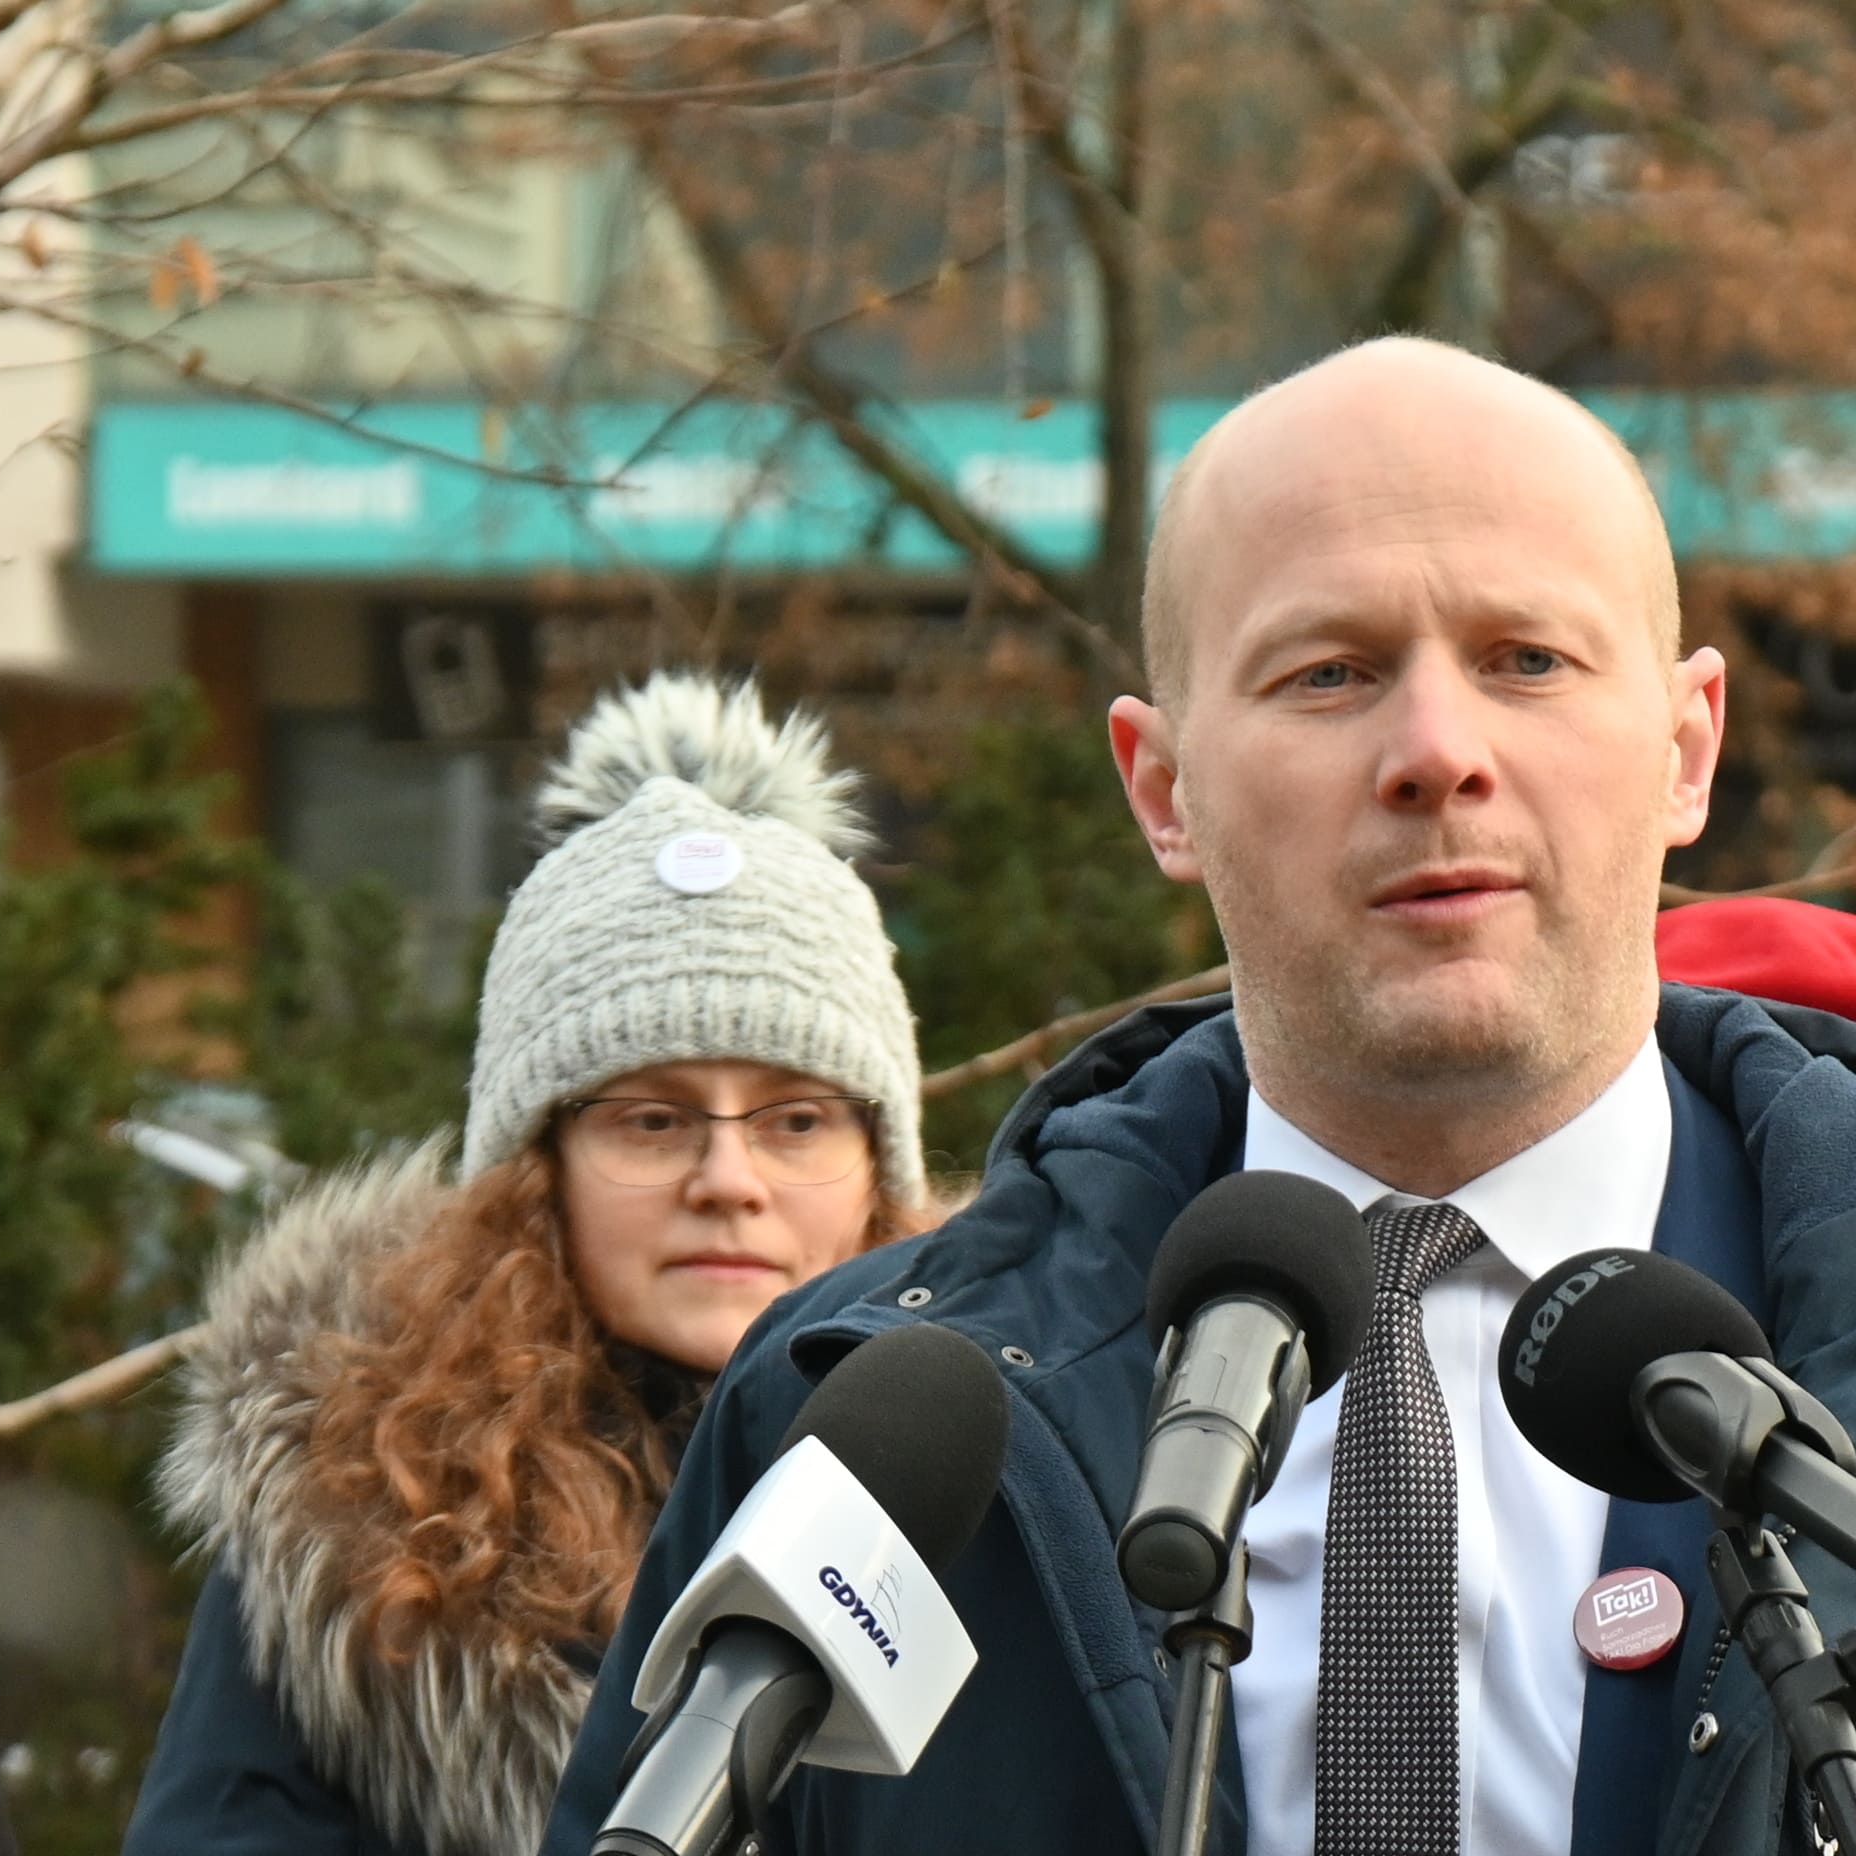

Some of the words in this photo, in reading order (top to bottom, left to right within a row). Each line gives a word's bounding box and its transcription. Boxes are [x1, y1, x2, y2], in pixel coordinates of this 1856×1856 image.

[1514, 1255, 1635, 1388] RØDE
[818, 1565, 900, 1670] GDYNIA
[1600, 1585, 1651, 1615] Tak!
